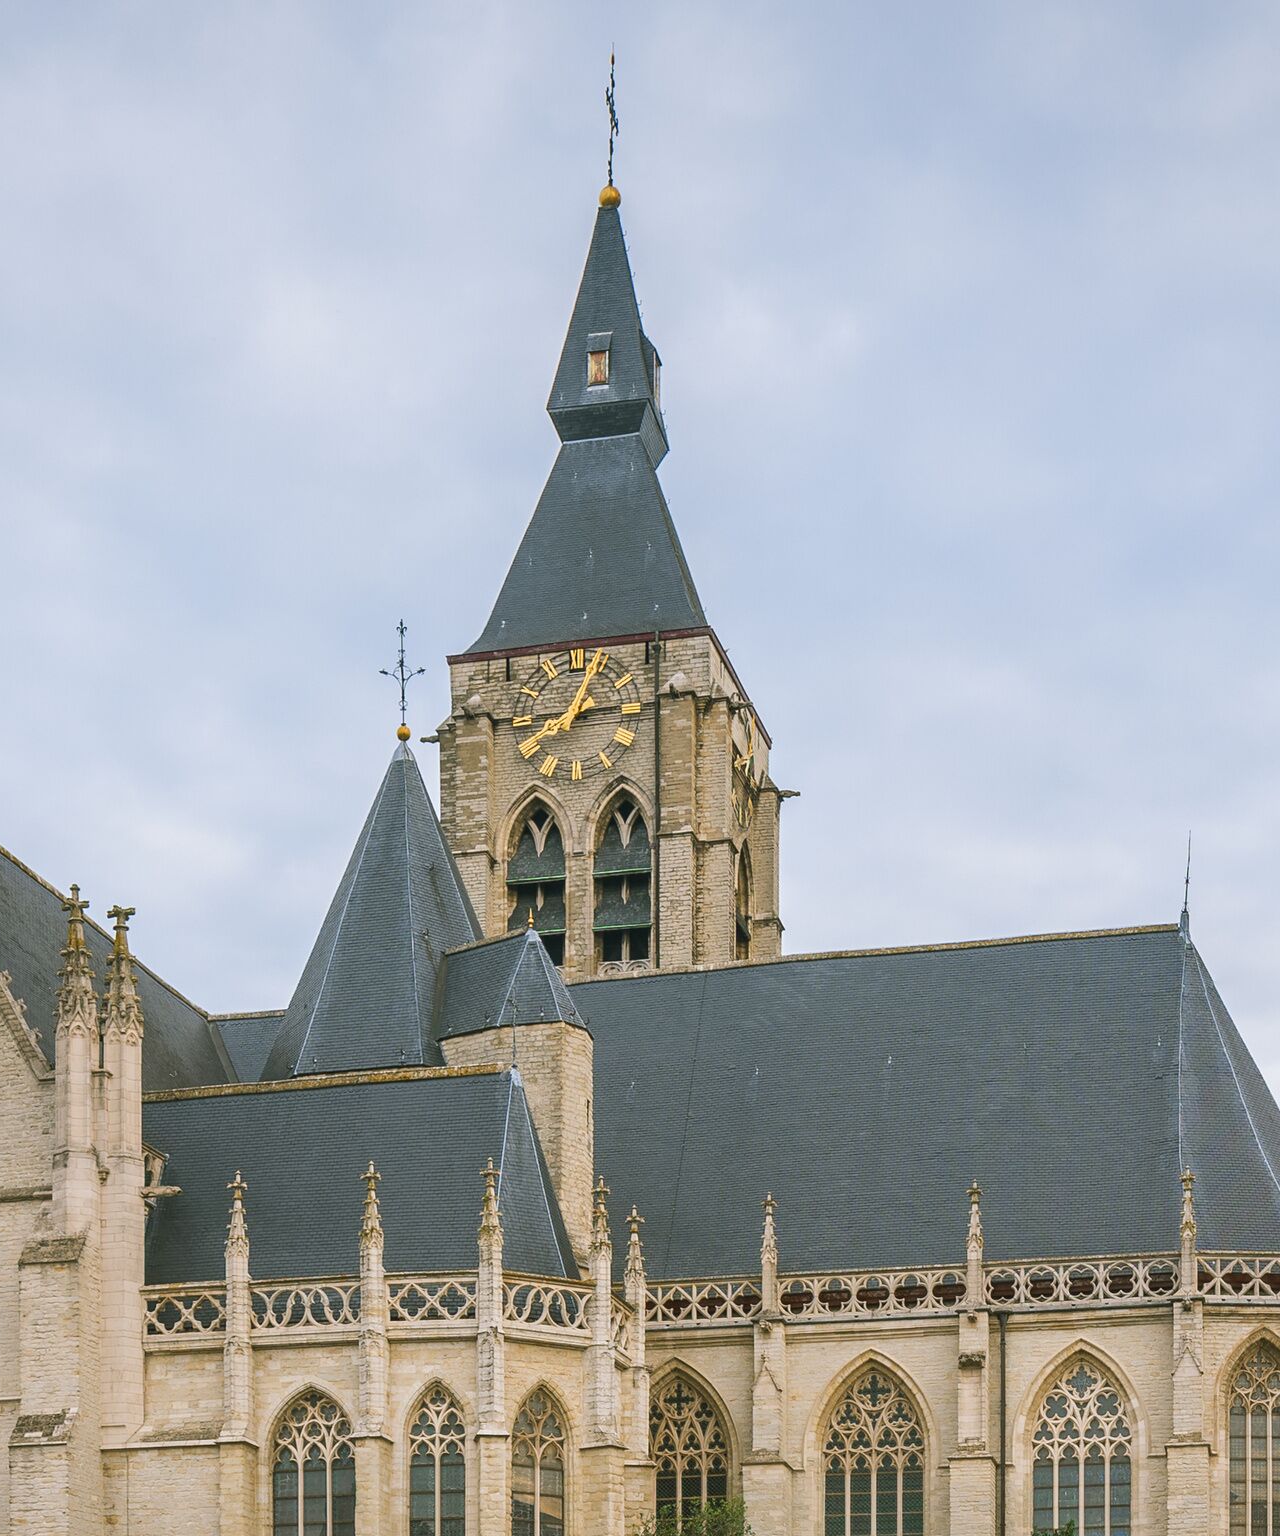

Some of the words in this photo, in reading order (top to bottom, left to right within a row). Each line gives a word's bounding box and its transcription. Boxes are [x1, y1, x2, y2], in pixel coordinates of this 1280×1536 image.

[570, 649, 584, 669] XII
[541, 659, 558, 680] XI
[614, 672, 633, 689] II
[520, 685, 539, 699] X
[621, 702, 641, 714] III
[512, 714, 532, 727] IX
[613, 727, 636, 747] IIII
[539, 754, 559, 777] VII
[599, 751, 612, 769] V
[571, 761, 582, 780] VI
